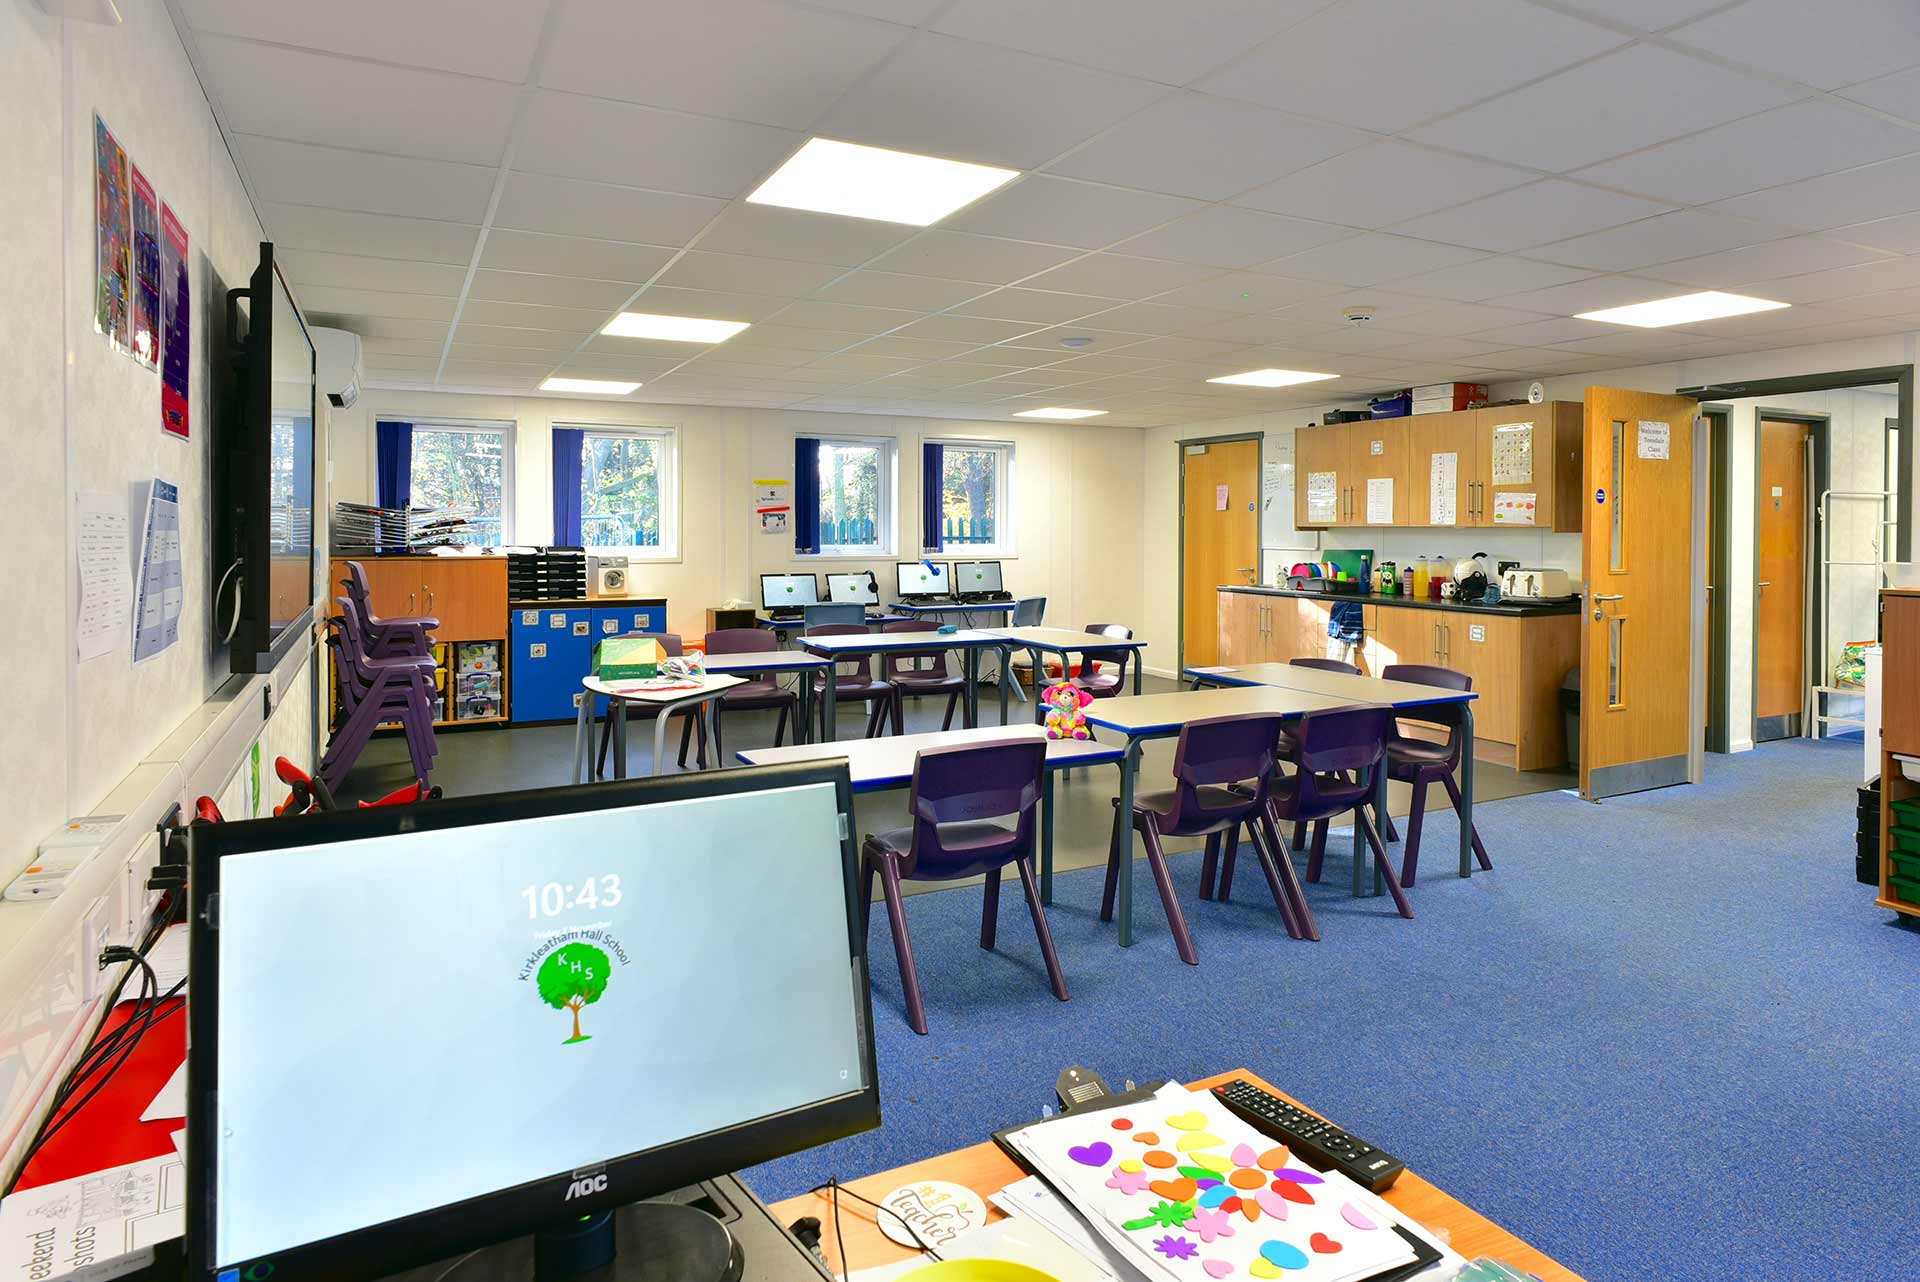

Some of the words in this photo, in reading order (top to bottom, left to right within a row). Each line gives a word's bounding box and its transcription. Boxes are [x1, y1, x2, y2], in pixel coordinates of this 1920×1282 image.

[521, 873, 623, 919] 10:43
[518, 931, 579, 982] Kirkleatham
[580, 929, 604, 942] Hall
[602, 934, 632, 966] School
[564, 1174, 608, 1201] AOC
[890, 1188, 957, 1246] Teacher
[20, 1226, 57, 1280] eekend
[63, 1226, 96, 1271] shots
